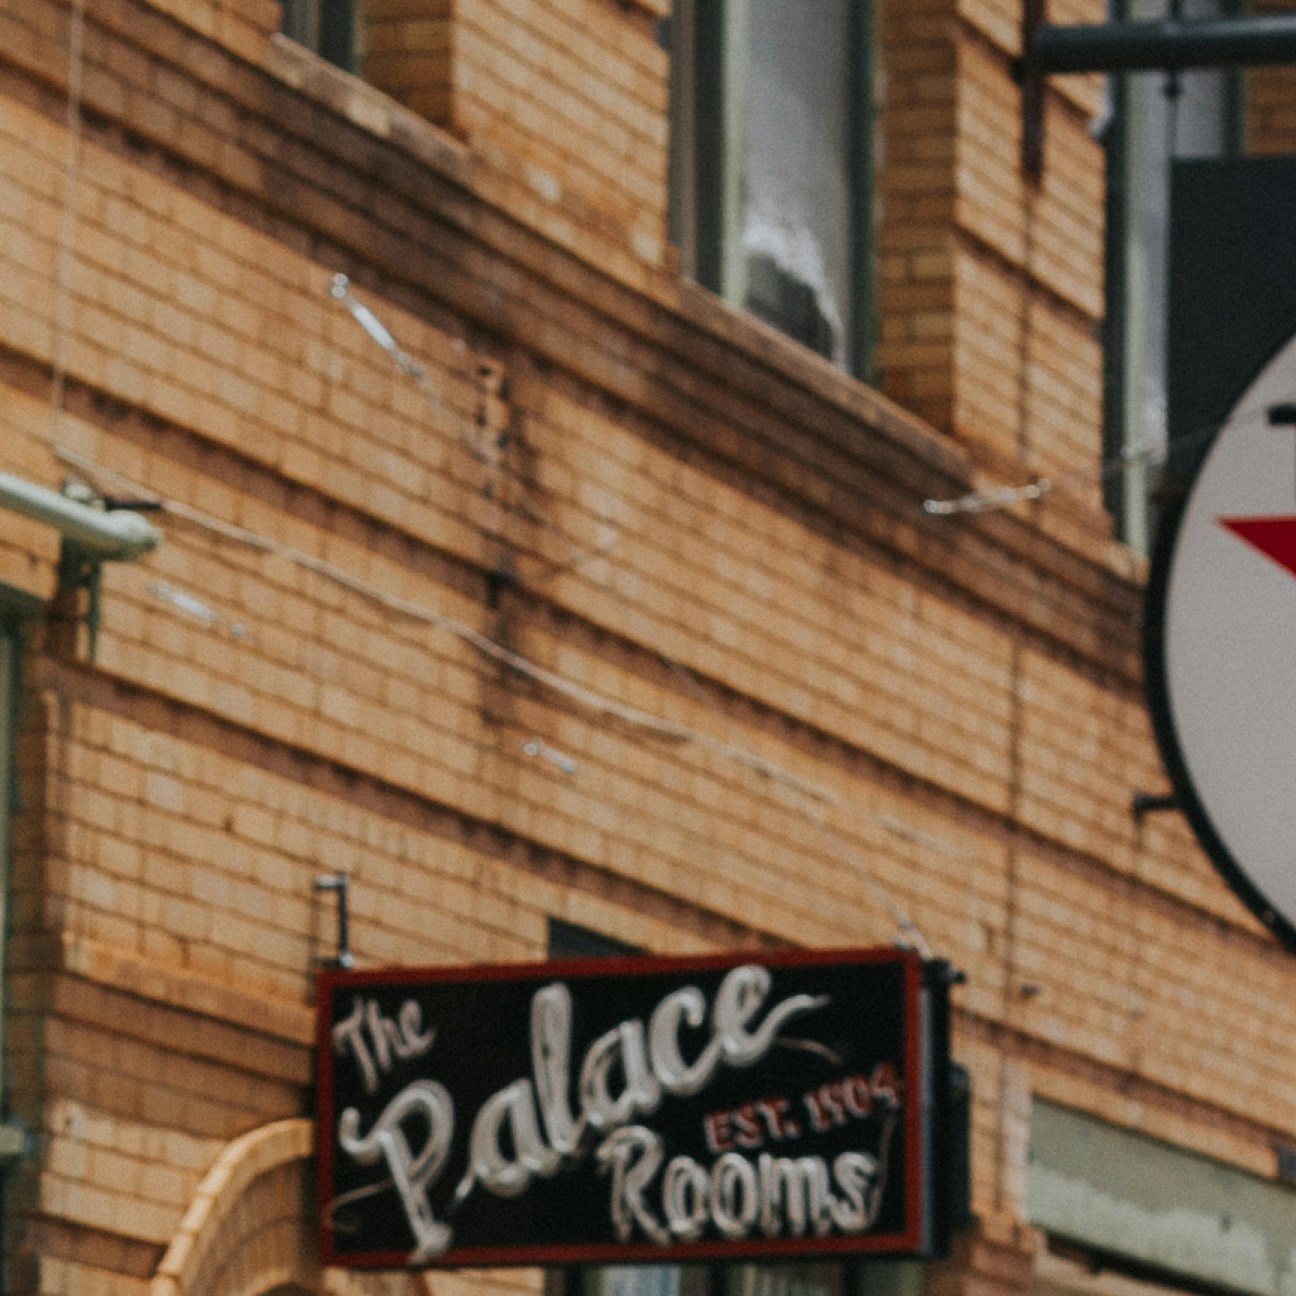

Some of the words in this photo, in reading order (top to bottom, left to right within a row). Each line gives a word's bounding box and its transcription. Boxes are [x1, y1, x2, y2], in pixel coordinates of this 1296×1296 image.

[335, 1000, 436, 1093] The
[340, 964, 829, 1260] Palace
[705, 1100, 801, 1152] EST.
[600, 1126, 879, 1244] Rooms
